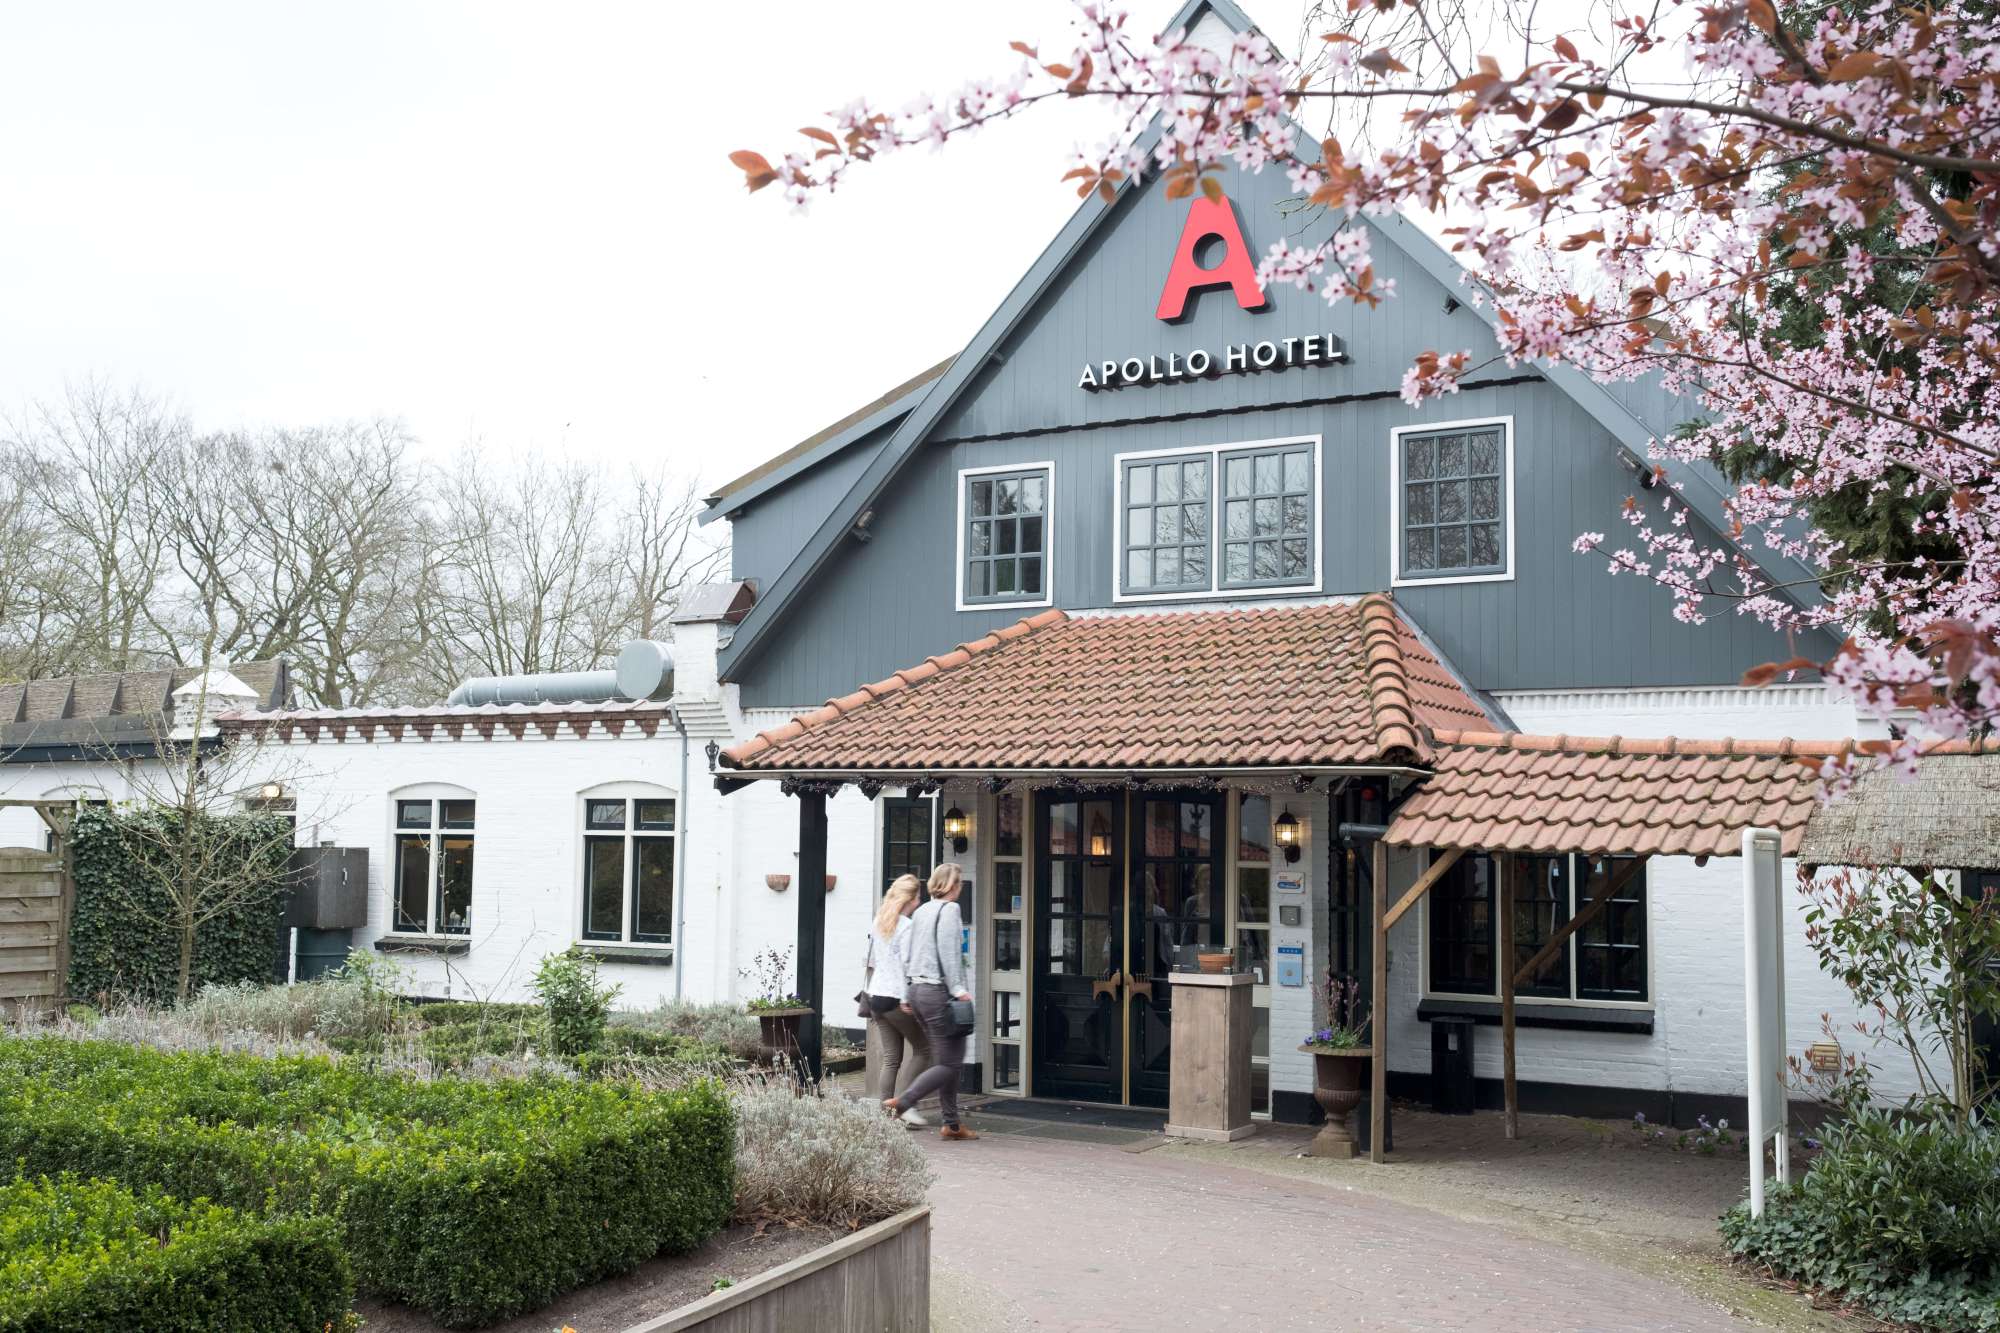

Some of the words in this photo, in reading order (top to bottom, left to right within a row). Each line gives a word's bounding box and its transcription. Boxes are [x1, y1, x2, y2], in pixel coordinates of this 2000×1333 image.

[1155, 195, 1265, 319] A
[1078, 349, 1210, 387] APOLLO
[1226, 332, 1342, 370] HOTEL
